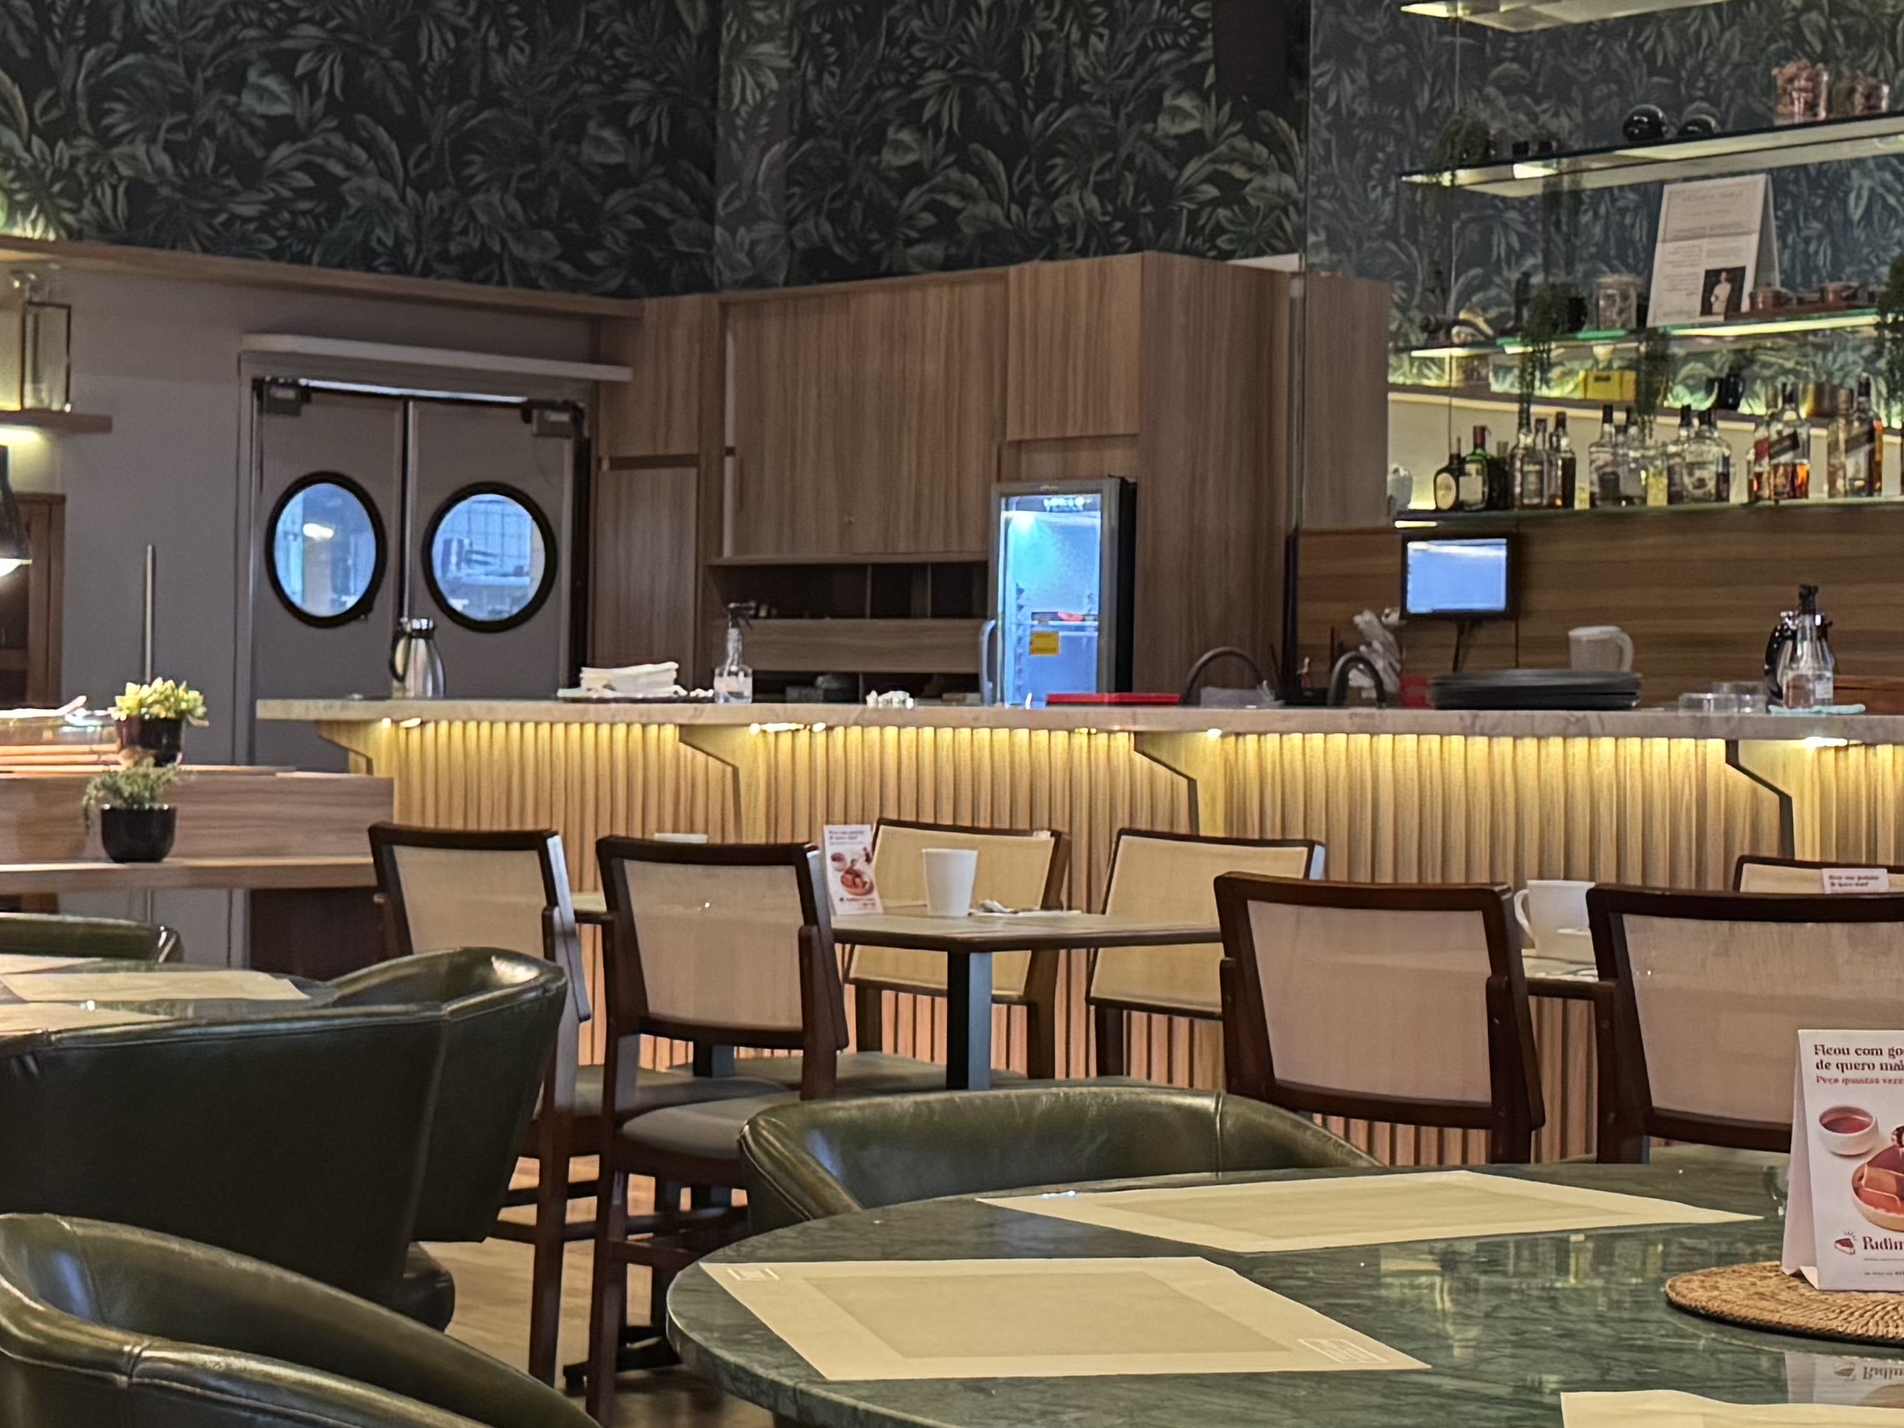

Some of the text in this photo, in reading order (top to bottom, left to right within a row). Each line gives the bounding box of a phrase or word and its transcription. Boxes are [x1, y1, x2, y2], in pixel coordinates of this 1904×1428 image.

[1813, 1044, 1851, 1057] Ficou
[1854, 1047, 1883, 1057] com
[1815, 1059, 1831, 1071] de
[1835, 1062, 1876, 1074] quero
